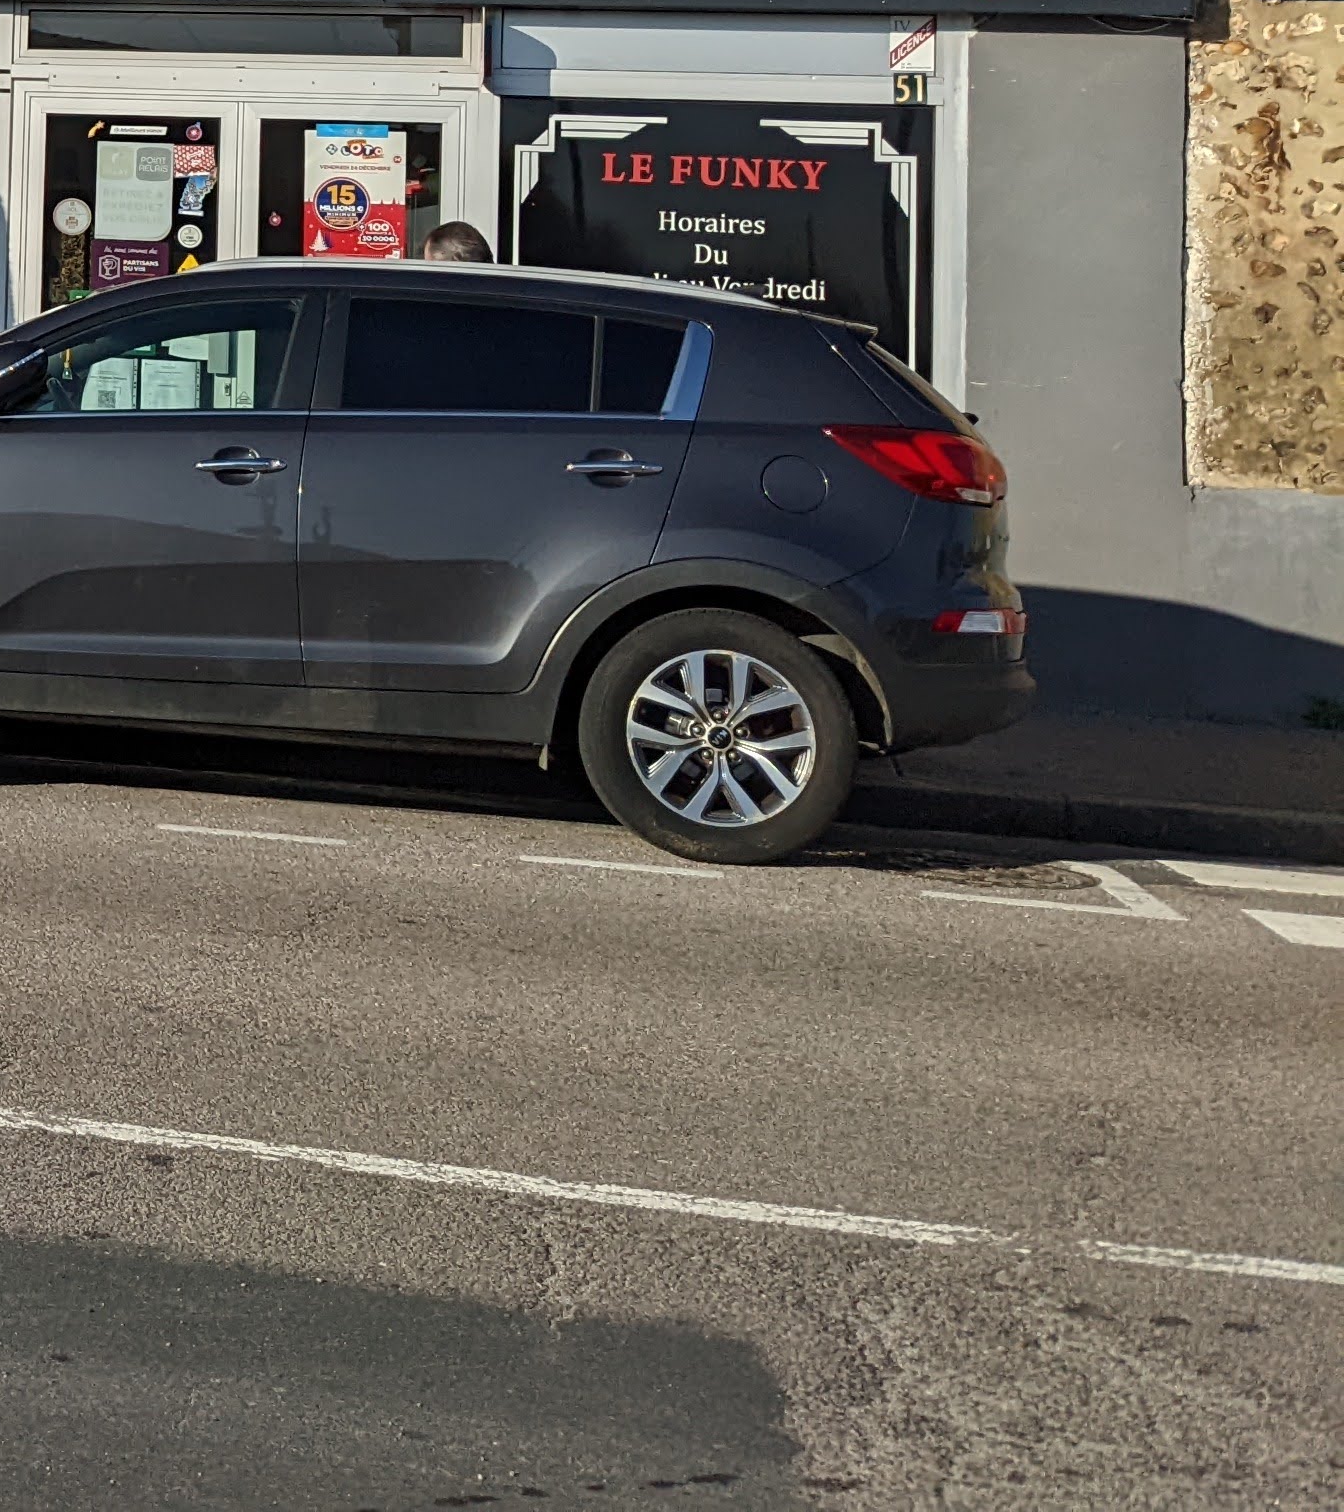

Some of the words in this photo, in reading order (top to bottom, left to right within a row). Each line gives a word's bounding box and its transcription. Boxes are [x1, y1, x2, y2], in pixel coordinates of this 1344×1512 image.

[894, 20, 911, 32] IV
[891, 21, 933, 63] LICENCE
[895, 74, 923, 103] 51
[340, 142, 383, 156] LOTO
[138, 164, 169, 173] RELAIS
[140, 156, 167, 165] POINT
[601, 153, 654, 184] LE
[670, 155, 828, 191] FUNKY
[326, 184, 356, 205] 15
[319, 204, 356, 212] MILLIONS
[367, 222, 390, 231] 100
[658, 210, 766, 235] Horaires
[693, 243, 729, 265] Du
[122, 259, 159, 267] PARTISANS
[712, 276, 826, 301] Vdredi
